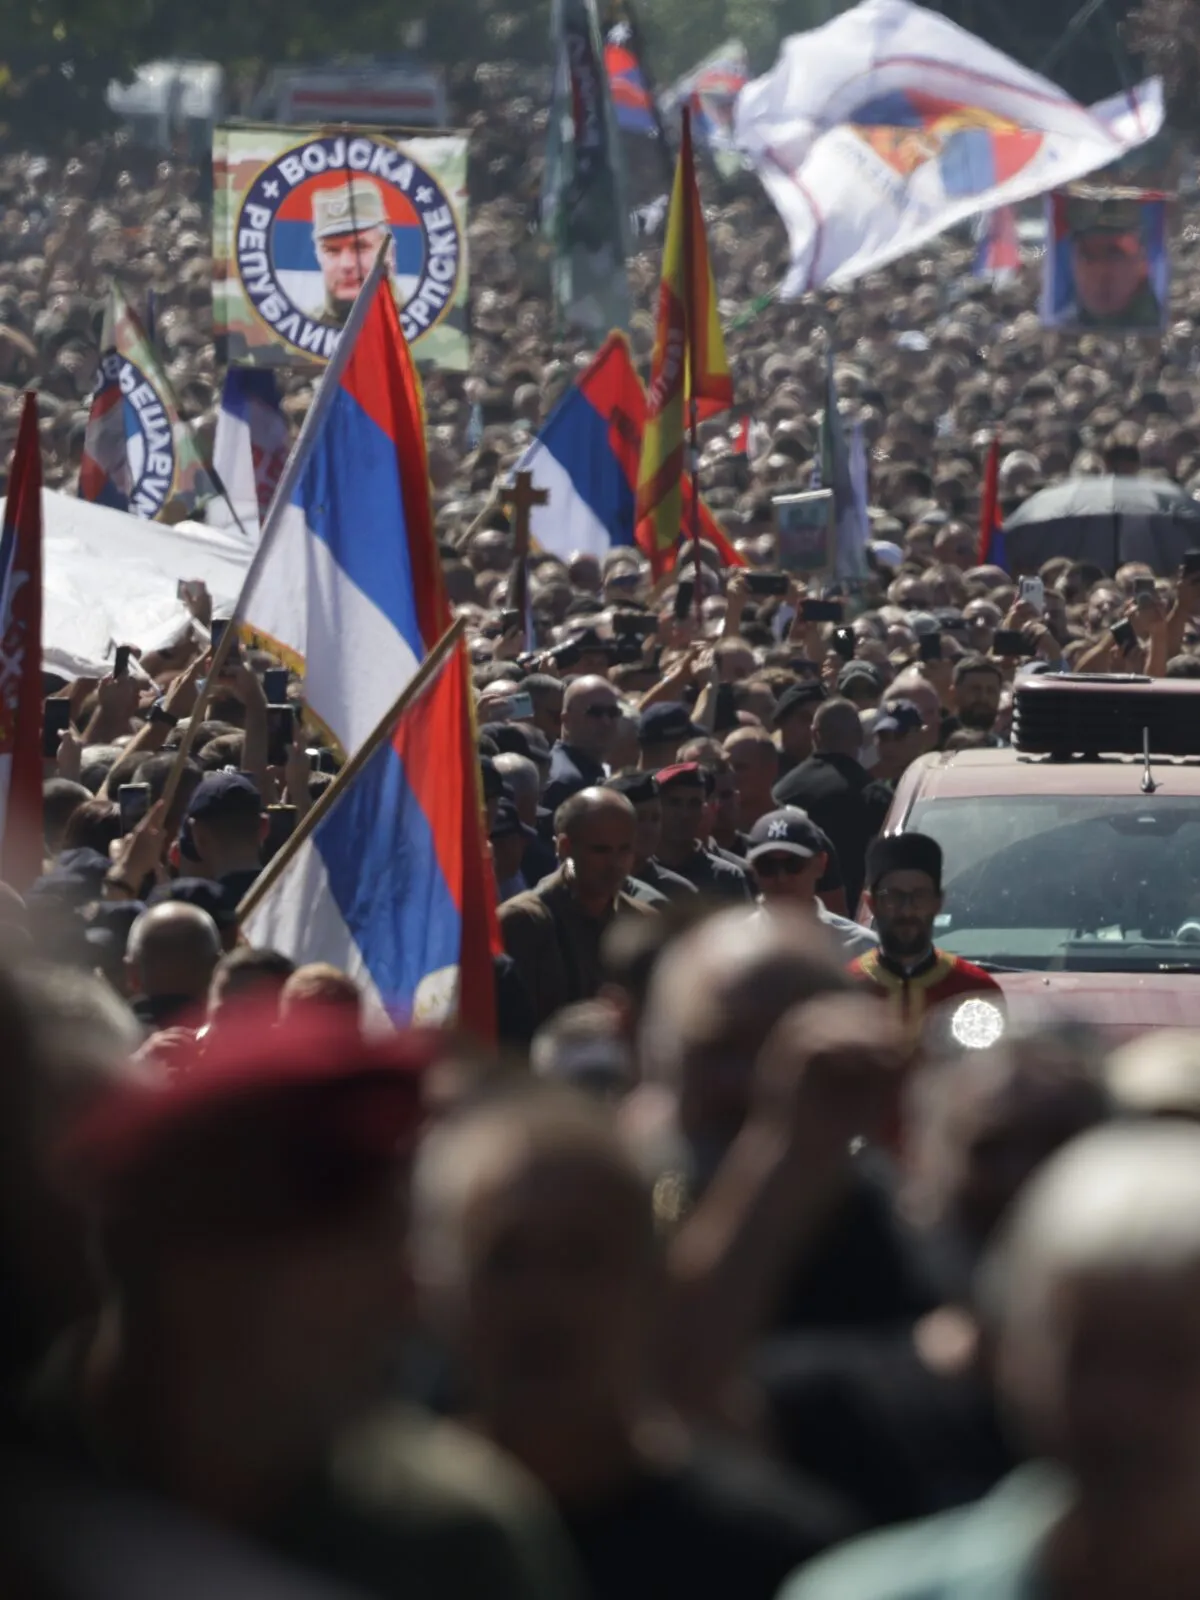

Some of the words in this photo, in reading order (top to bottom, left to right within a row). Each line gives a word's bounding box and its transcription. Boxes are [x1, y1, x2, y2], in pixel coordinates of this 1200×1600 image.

[277, 137, 414, 190] ВОЈСКА
[239, 203, 342, 356] РЕПУБЛИК
[399, 204, 457, 339] СРПСКЕ
